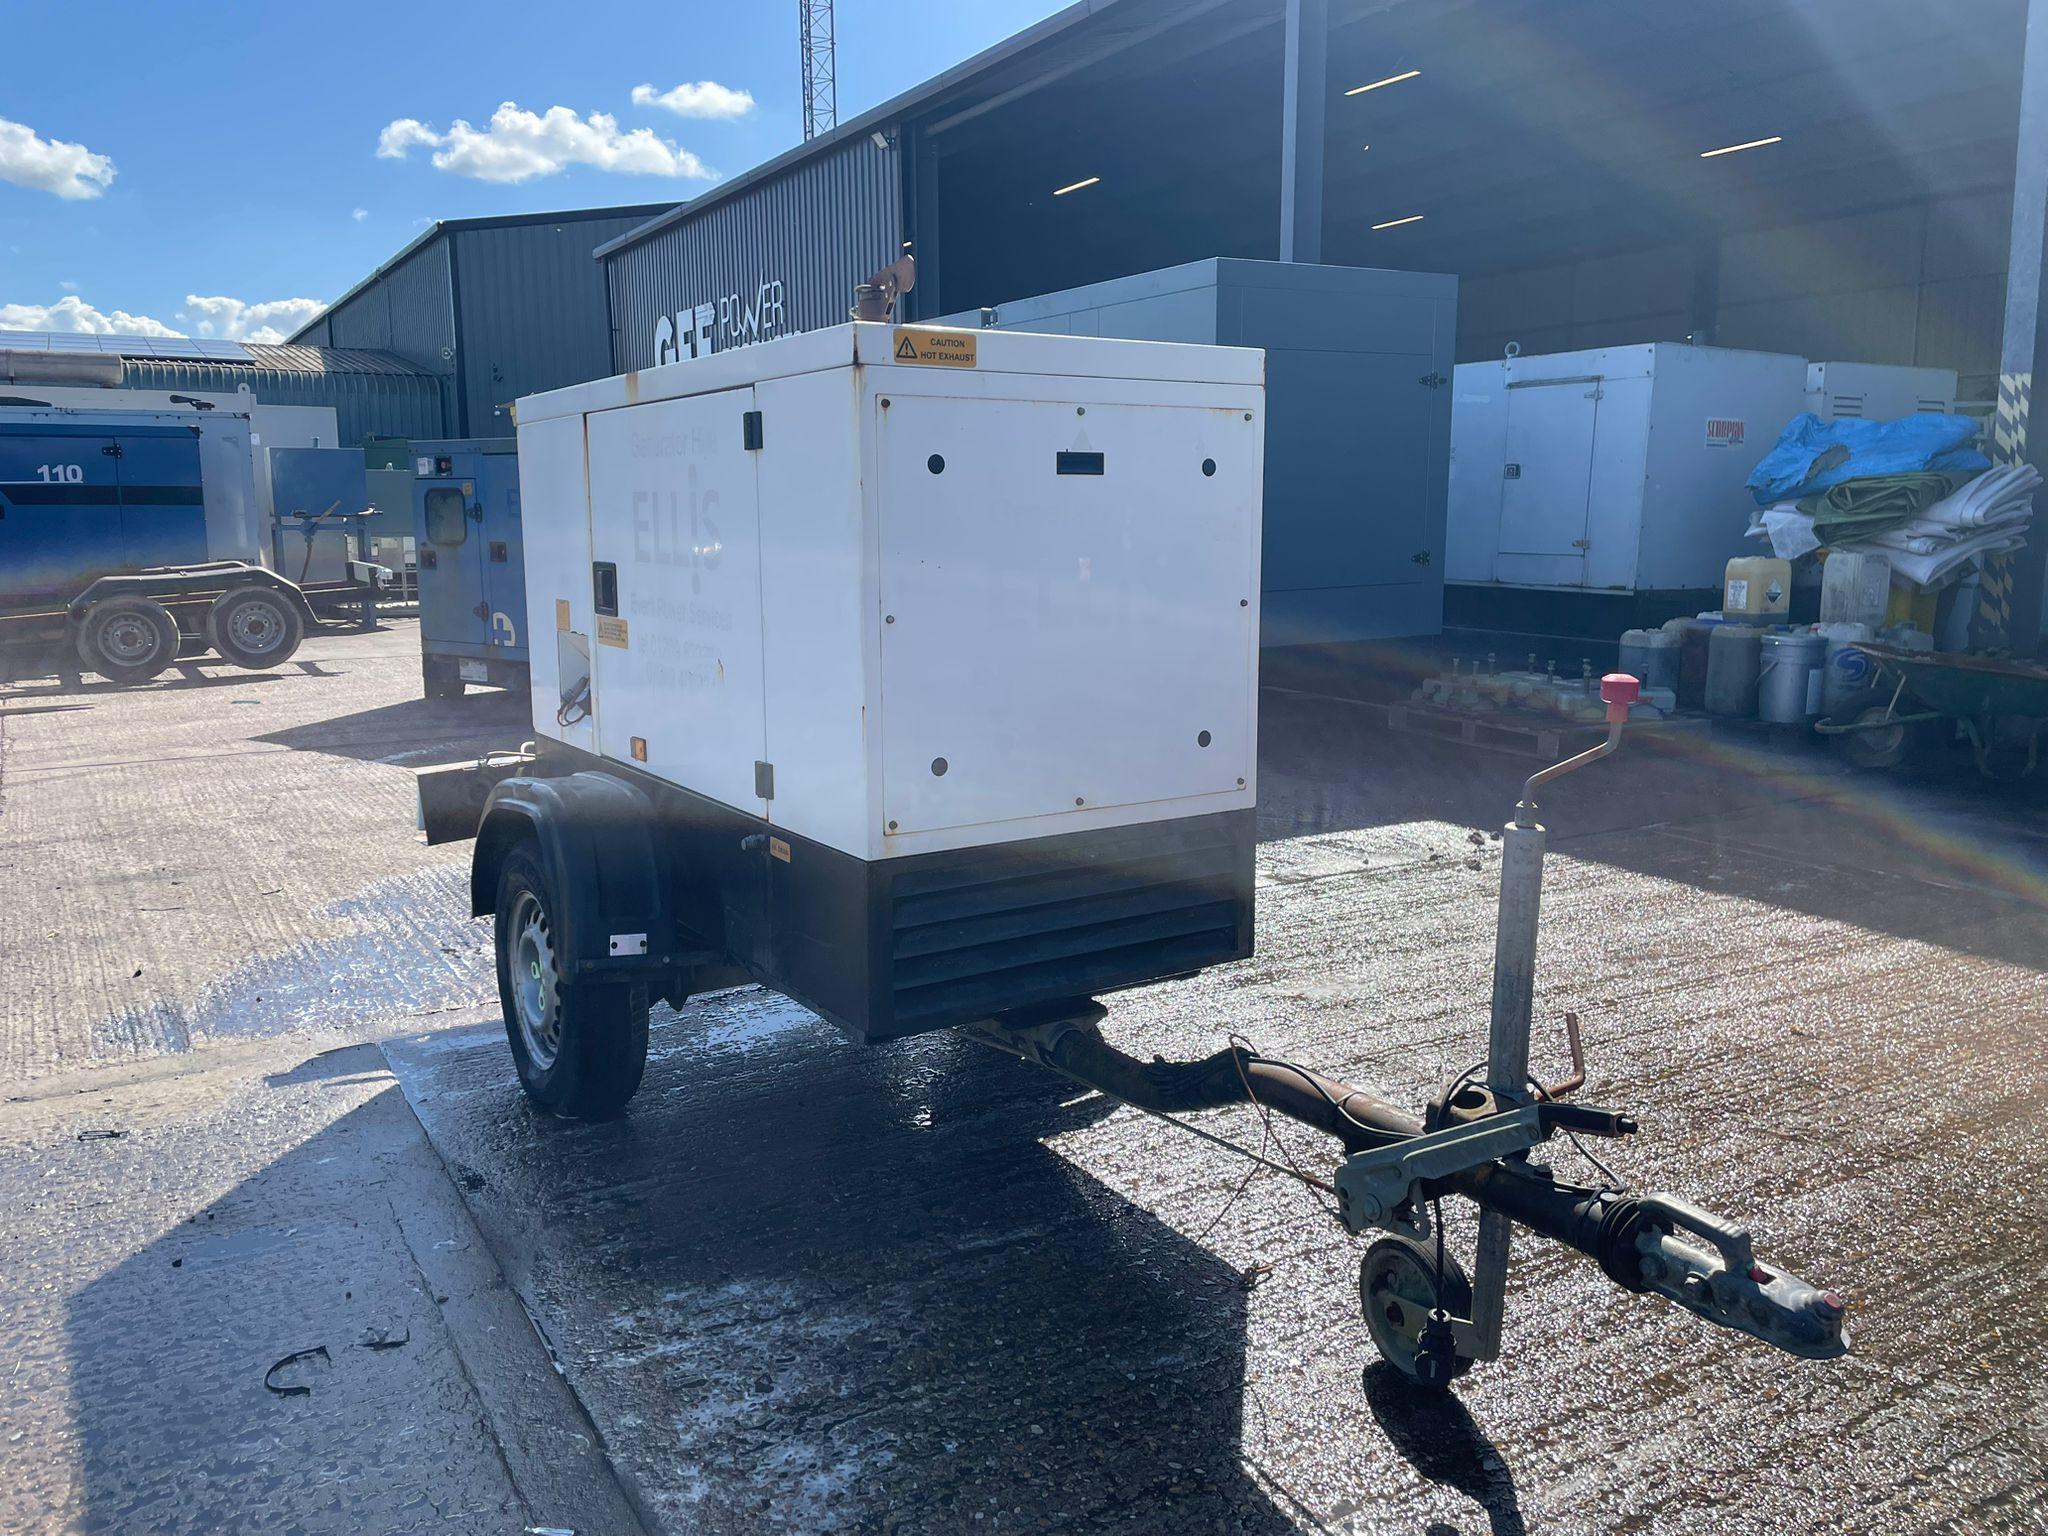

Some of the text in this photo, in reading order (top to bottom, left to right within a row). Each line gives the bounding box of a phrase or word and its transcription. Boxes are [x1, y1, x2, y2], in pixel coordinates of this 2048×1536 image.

[720, 269, 784, 340] POWER
[930, 338, 965, 348] CAUTION
[920, 351, 975, 362] HOT EXHAUST
[37, 464, 84, 483] 110
